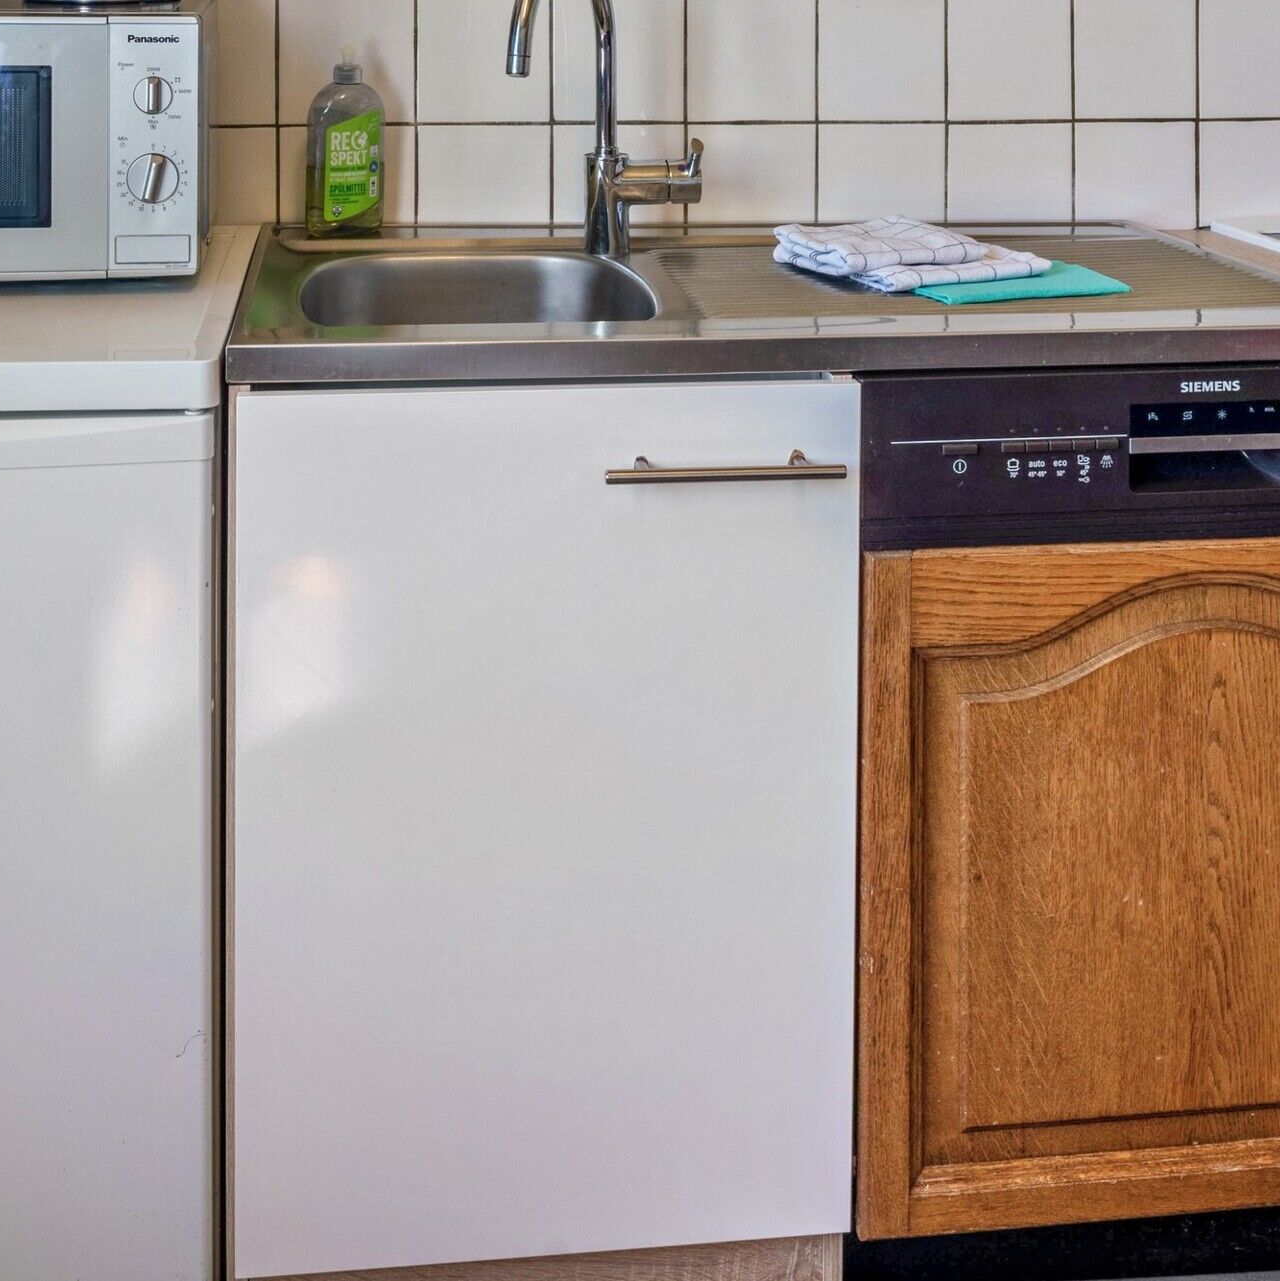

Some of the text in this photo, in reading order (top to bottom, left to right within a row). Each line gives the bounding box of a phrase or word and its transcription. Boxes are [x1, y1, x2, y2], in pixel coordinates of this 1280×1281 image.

[127, 34, 180, 44] Panasonic
[330, 150, 367, 166] SPEKT
[1180, 380, 1241, 393] SIEMENS
[1028, 460, 1046, 468] auto
[1053, 459, 1068, 467] eco
